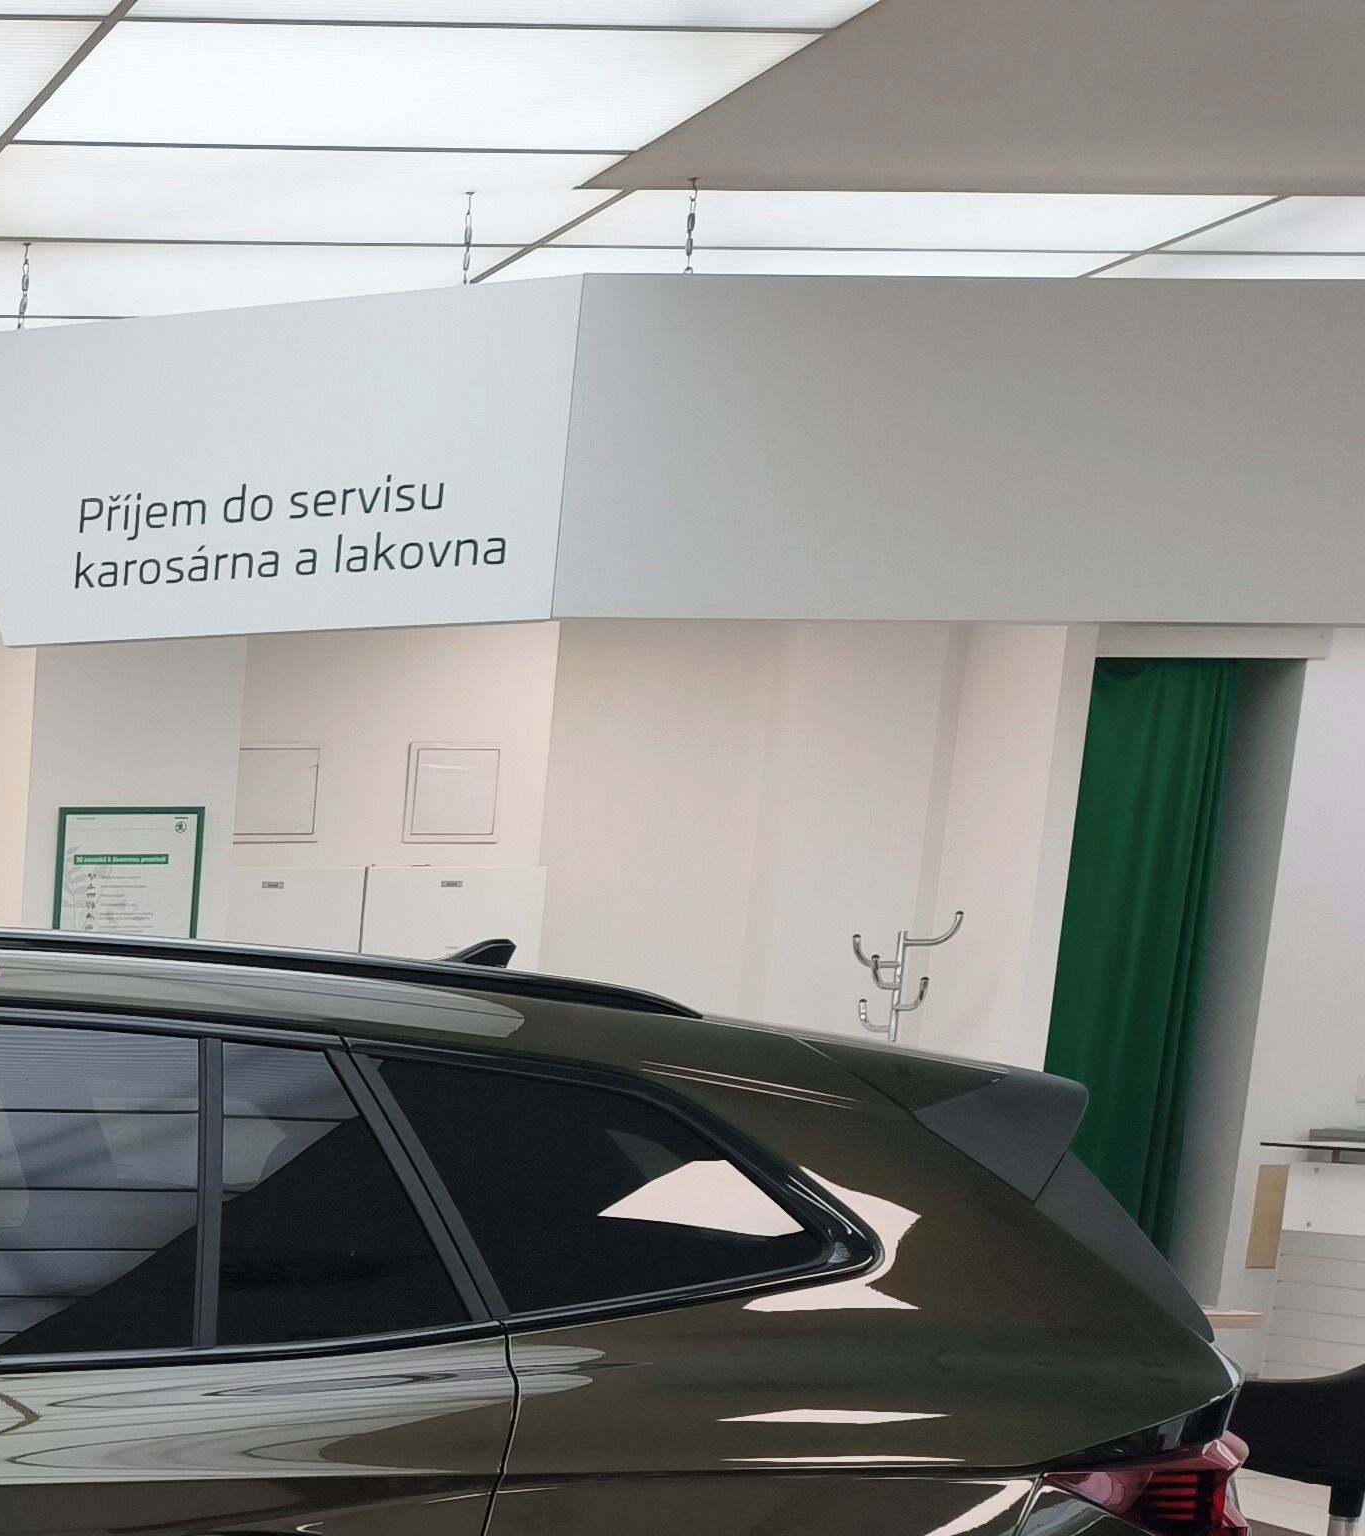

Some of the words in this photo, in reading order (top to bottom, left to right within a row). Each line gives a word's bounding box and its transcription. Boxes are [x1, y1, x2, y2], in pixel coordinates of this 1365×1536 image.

[78, 492, 207, 542] Příjem
[223, 483, 273, 524] do
[289, 474, 445, 520] servisu
[74, 544, 280, 590] karosárna
[295, 547, 317, 576] a
[334, 531, 507, 574] lakovna
